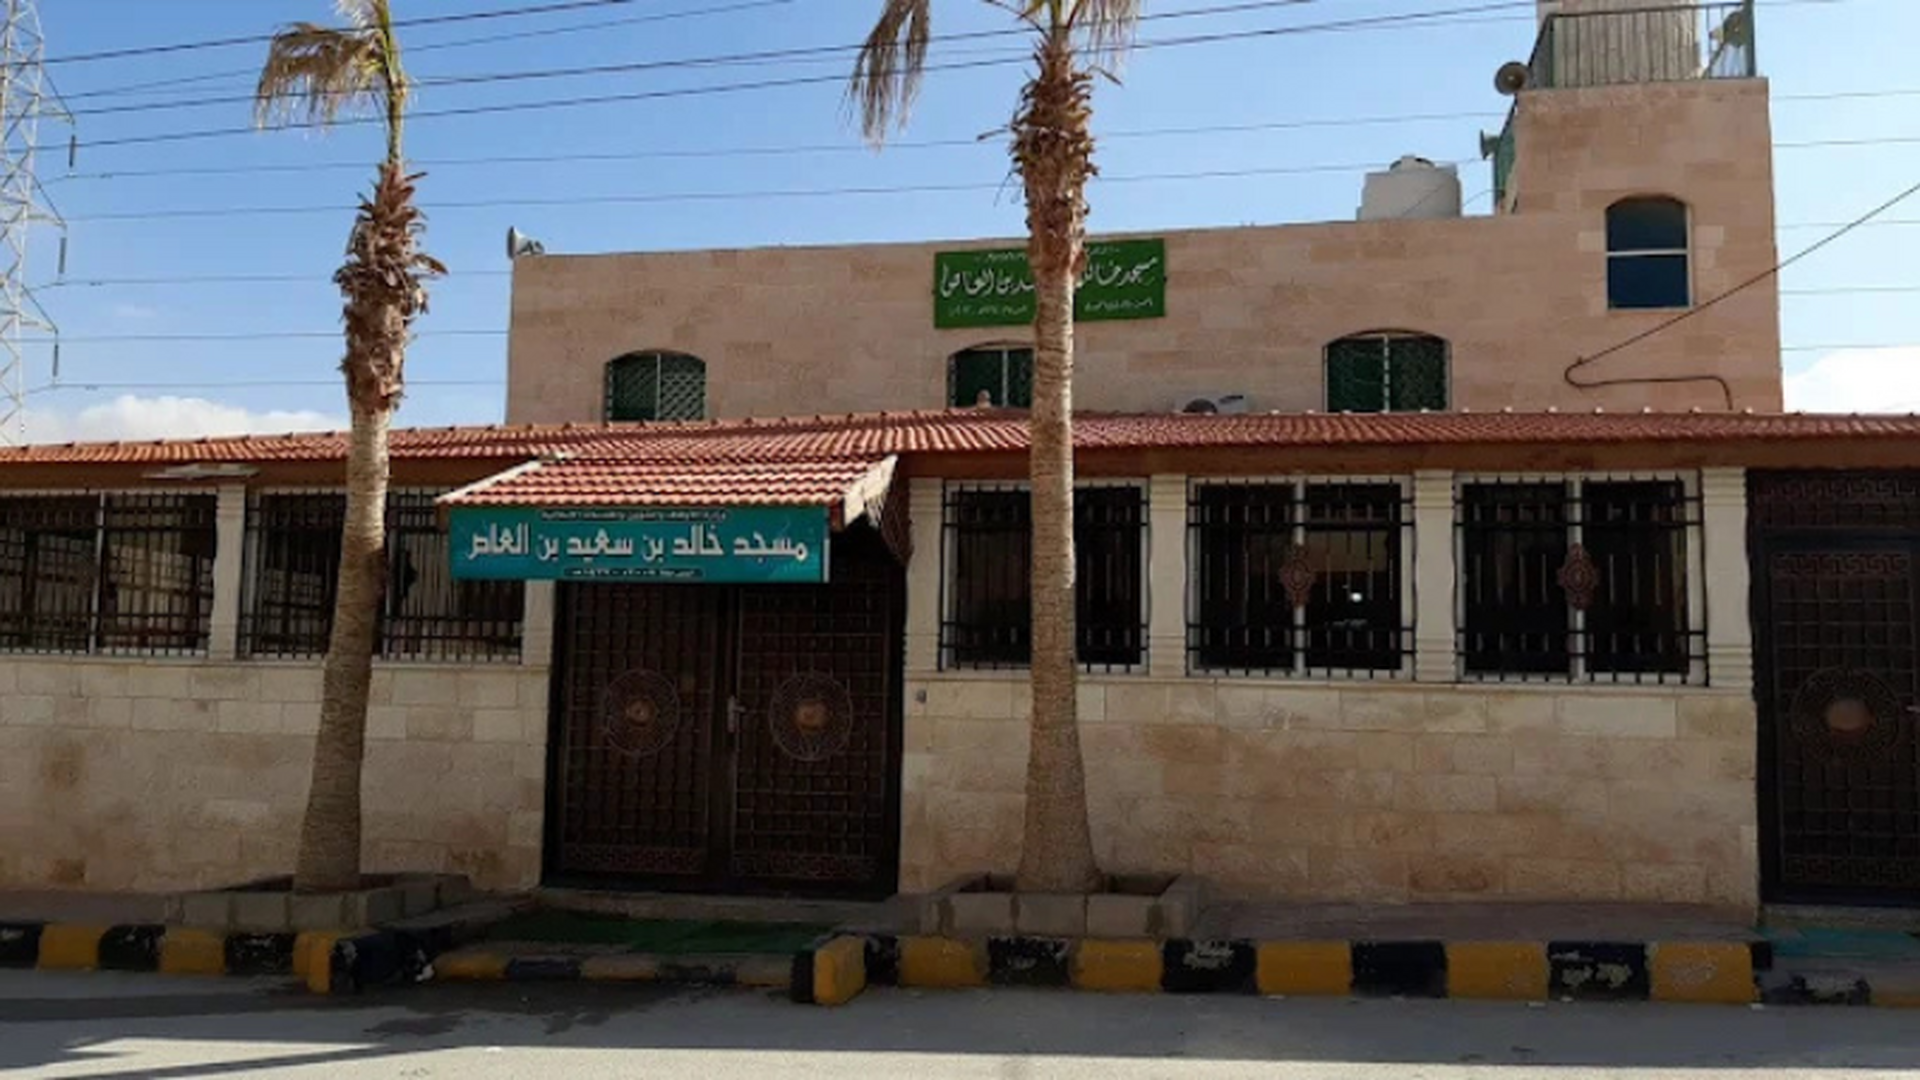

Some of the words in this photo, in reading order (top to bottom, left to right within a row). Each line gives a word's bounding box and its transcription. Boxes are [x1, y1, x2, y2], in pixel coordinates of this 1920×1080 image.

[467, 522, 530, 561] العاص
[535, 533, 560, 561] بن
[567, 528, 634, 563] سعيد
[642, 533, 664, 562] بن
[672, 523, 725, 556] خالد
[734, 530, 808, 563] مسجد
